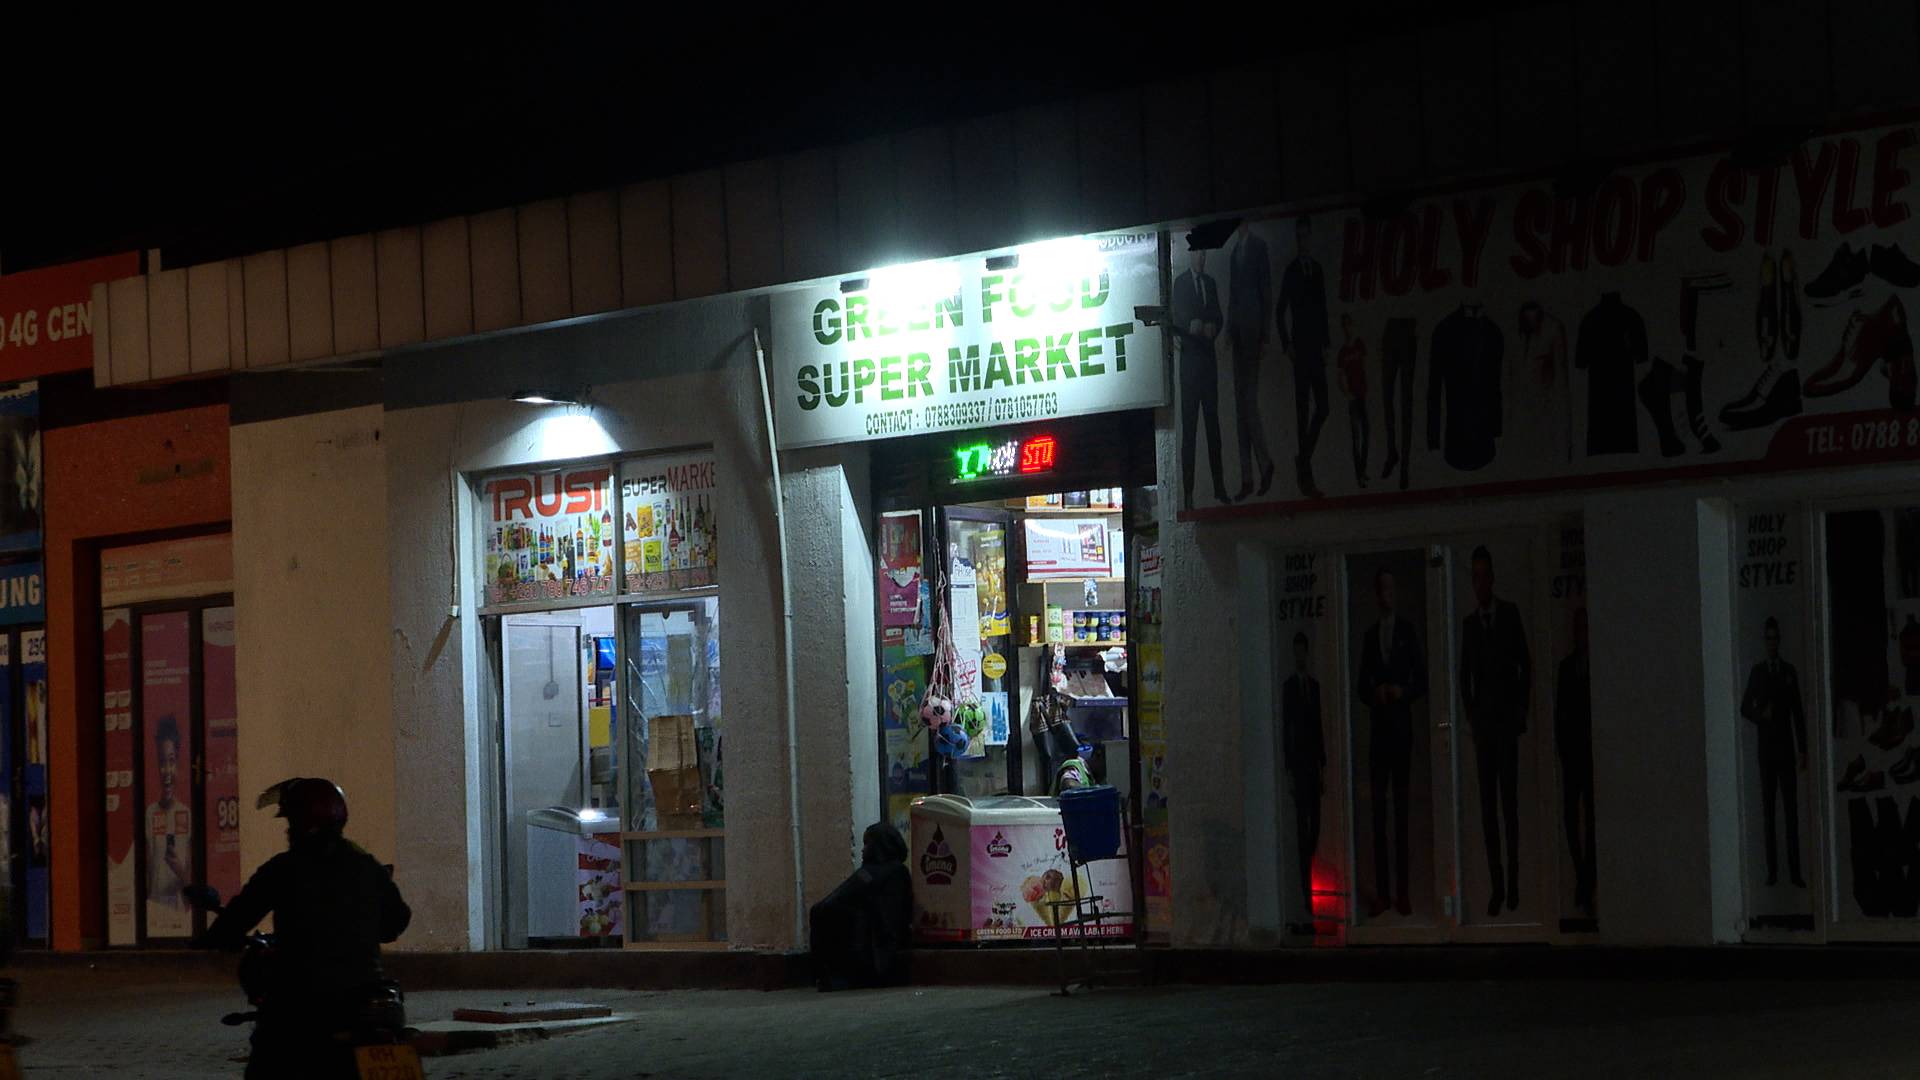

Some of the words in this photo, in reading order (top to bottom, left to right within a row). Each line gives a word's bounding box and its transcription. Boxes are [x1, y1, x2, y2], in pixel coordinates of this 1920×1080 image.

[1339, 195, 1498, 303] HOLY
[1509, 168, 1686, 280] SHOP
[1700, 127, 1919, 253] STYLE
[981, 266, 1110, 324] FOOD
[9, 309, 39, 348] 4G
[797, 351, 935, 411] SUPER
[948, 321, 1134, 394] MARKET
[1805, 425, 1844, 455] TEL:
[1851, 419, 1901, 451] 0788
[484, 468, 611, 522] TRUST
[1748, 512, 1786, 535] HOLY
[1747, 536, 1787, 558] SHOP
[1285, 552, 1316, 572] HOLY
[1739, 560, 1797, 589] STYLE
[510, 582, 539, 600] +250
[540, 579, 563, 598] 788
[590, 575, 613, 595] 747
[1285, 573, 1318, 594] SHOP
[1278, 595, 1326, 621] STYLE
[1030, 928, 1042, 937] ICE
[1042, 928, 1068, 937] CREM
[1106, 926, 1124, 936] HERE
